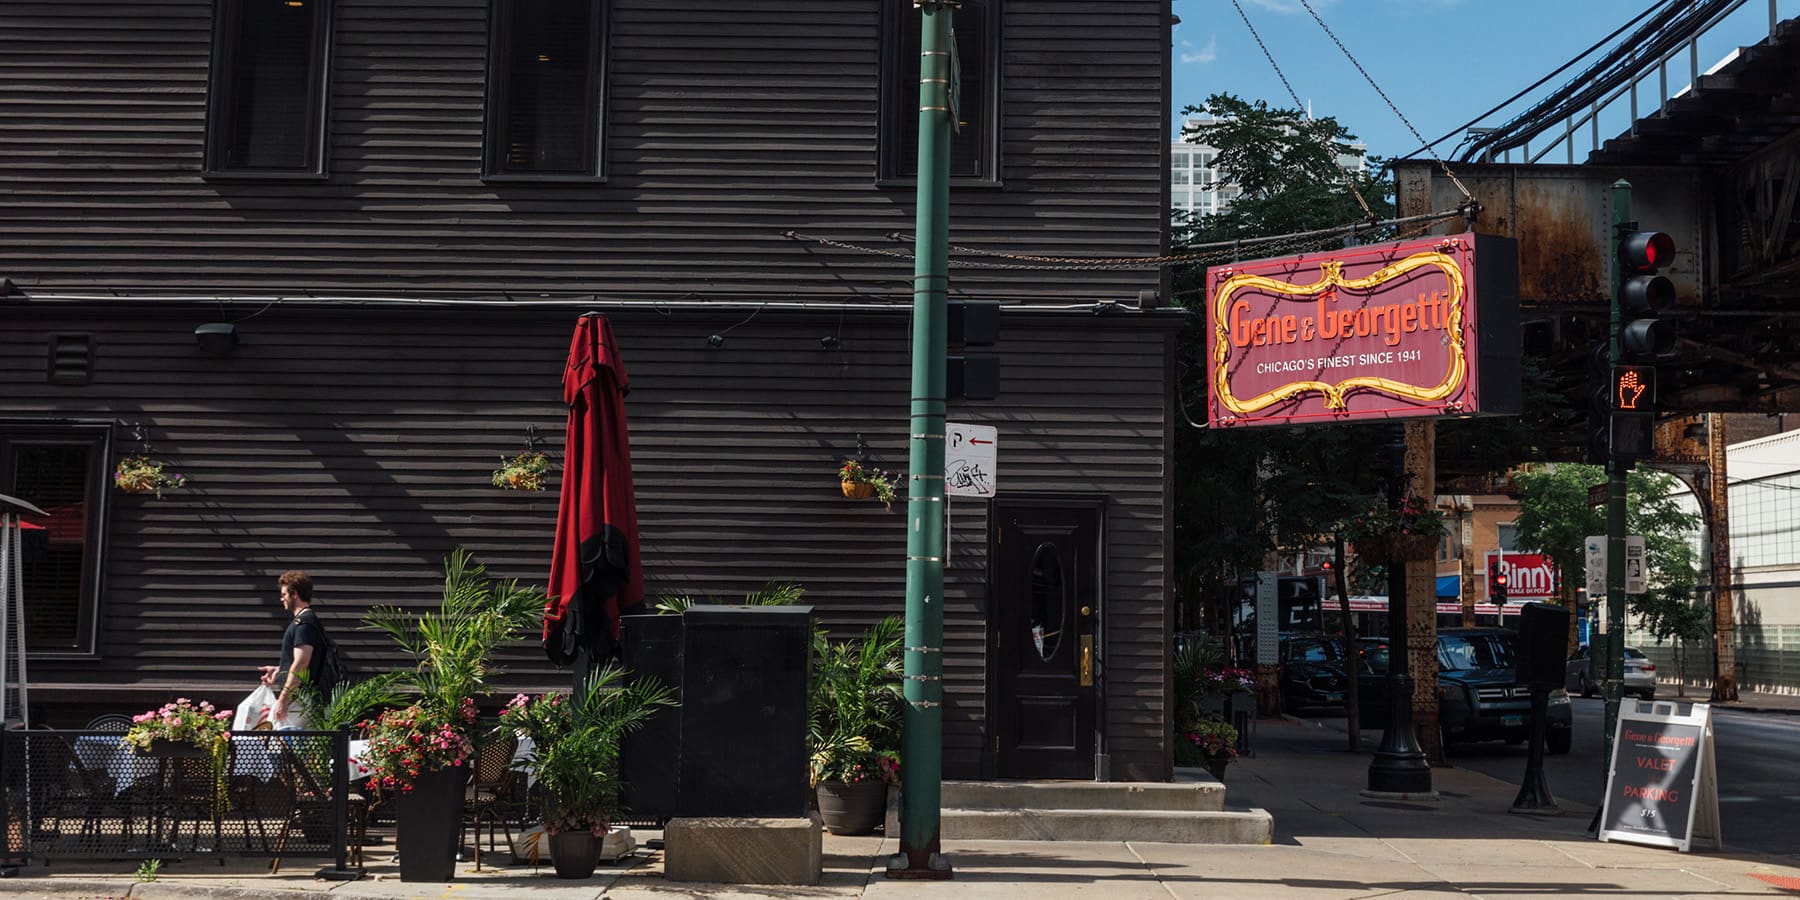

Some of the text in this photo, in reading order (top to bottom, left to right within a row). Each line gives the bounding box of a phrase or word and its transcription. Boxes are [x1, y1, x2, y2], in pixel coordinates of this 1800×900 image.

[1232, 291, 1449, 347] Gene & Georgetti
[1257, 350, 1421, 374] CHICAGO'S FINEST SINCE 1941
[1502, 561, 1558, 594] Binny
[1625, 730, 1646, 743] Gene
[1655, 732, 1695, 747] Georgetti
[1637, 757, 1676, 771] VALET
[1624, 786, 1678, 803] PARKING
[1640, 808, 1657, 818] $15
